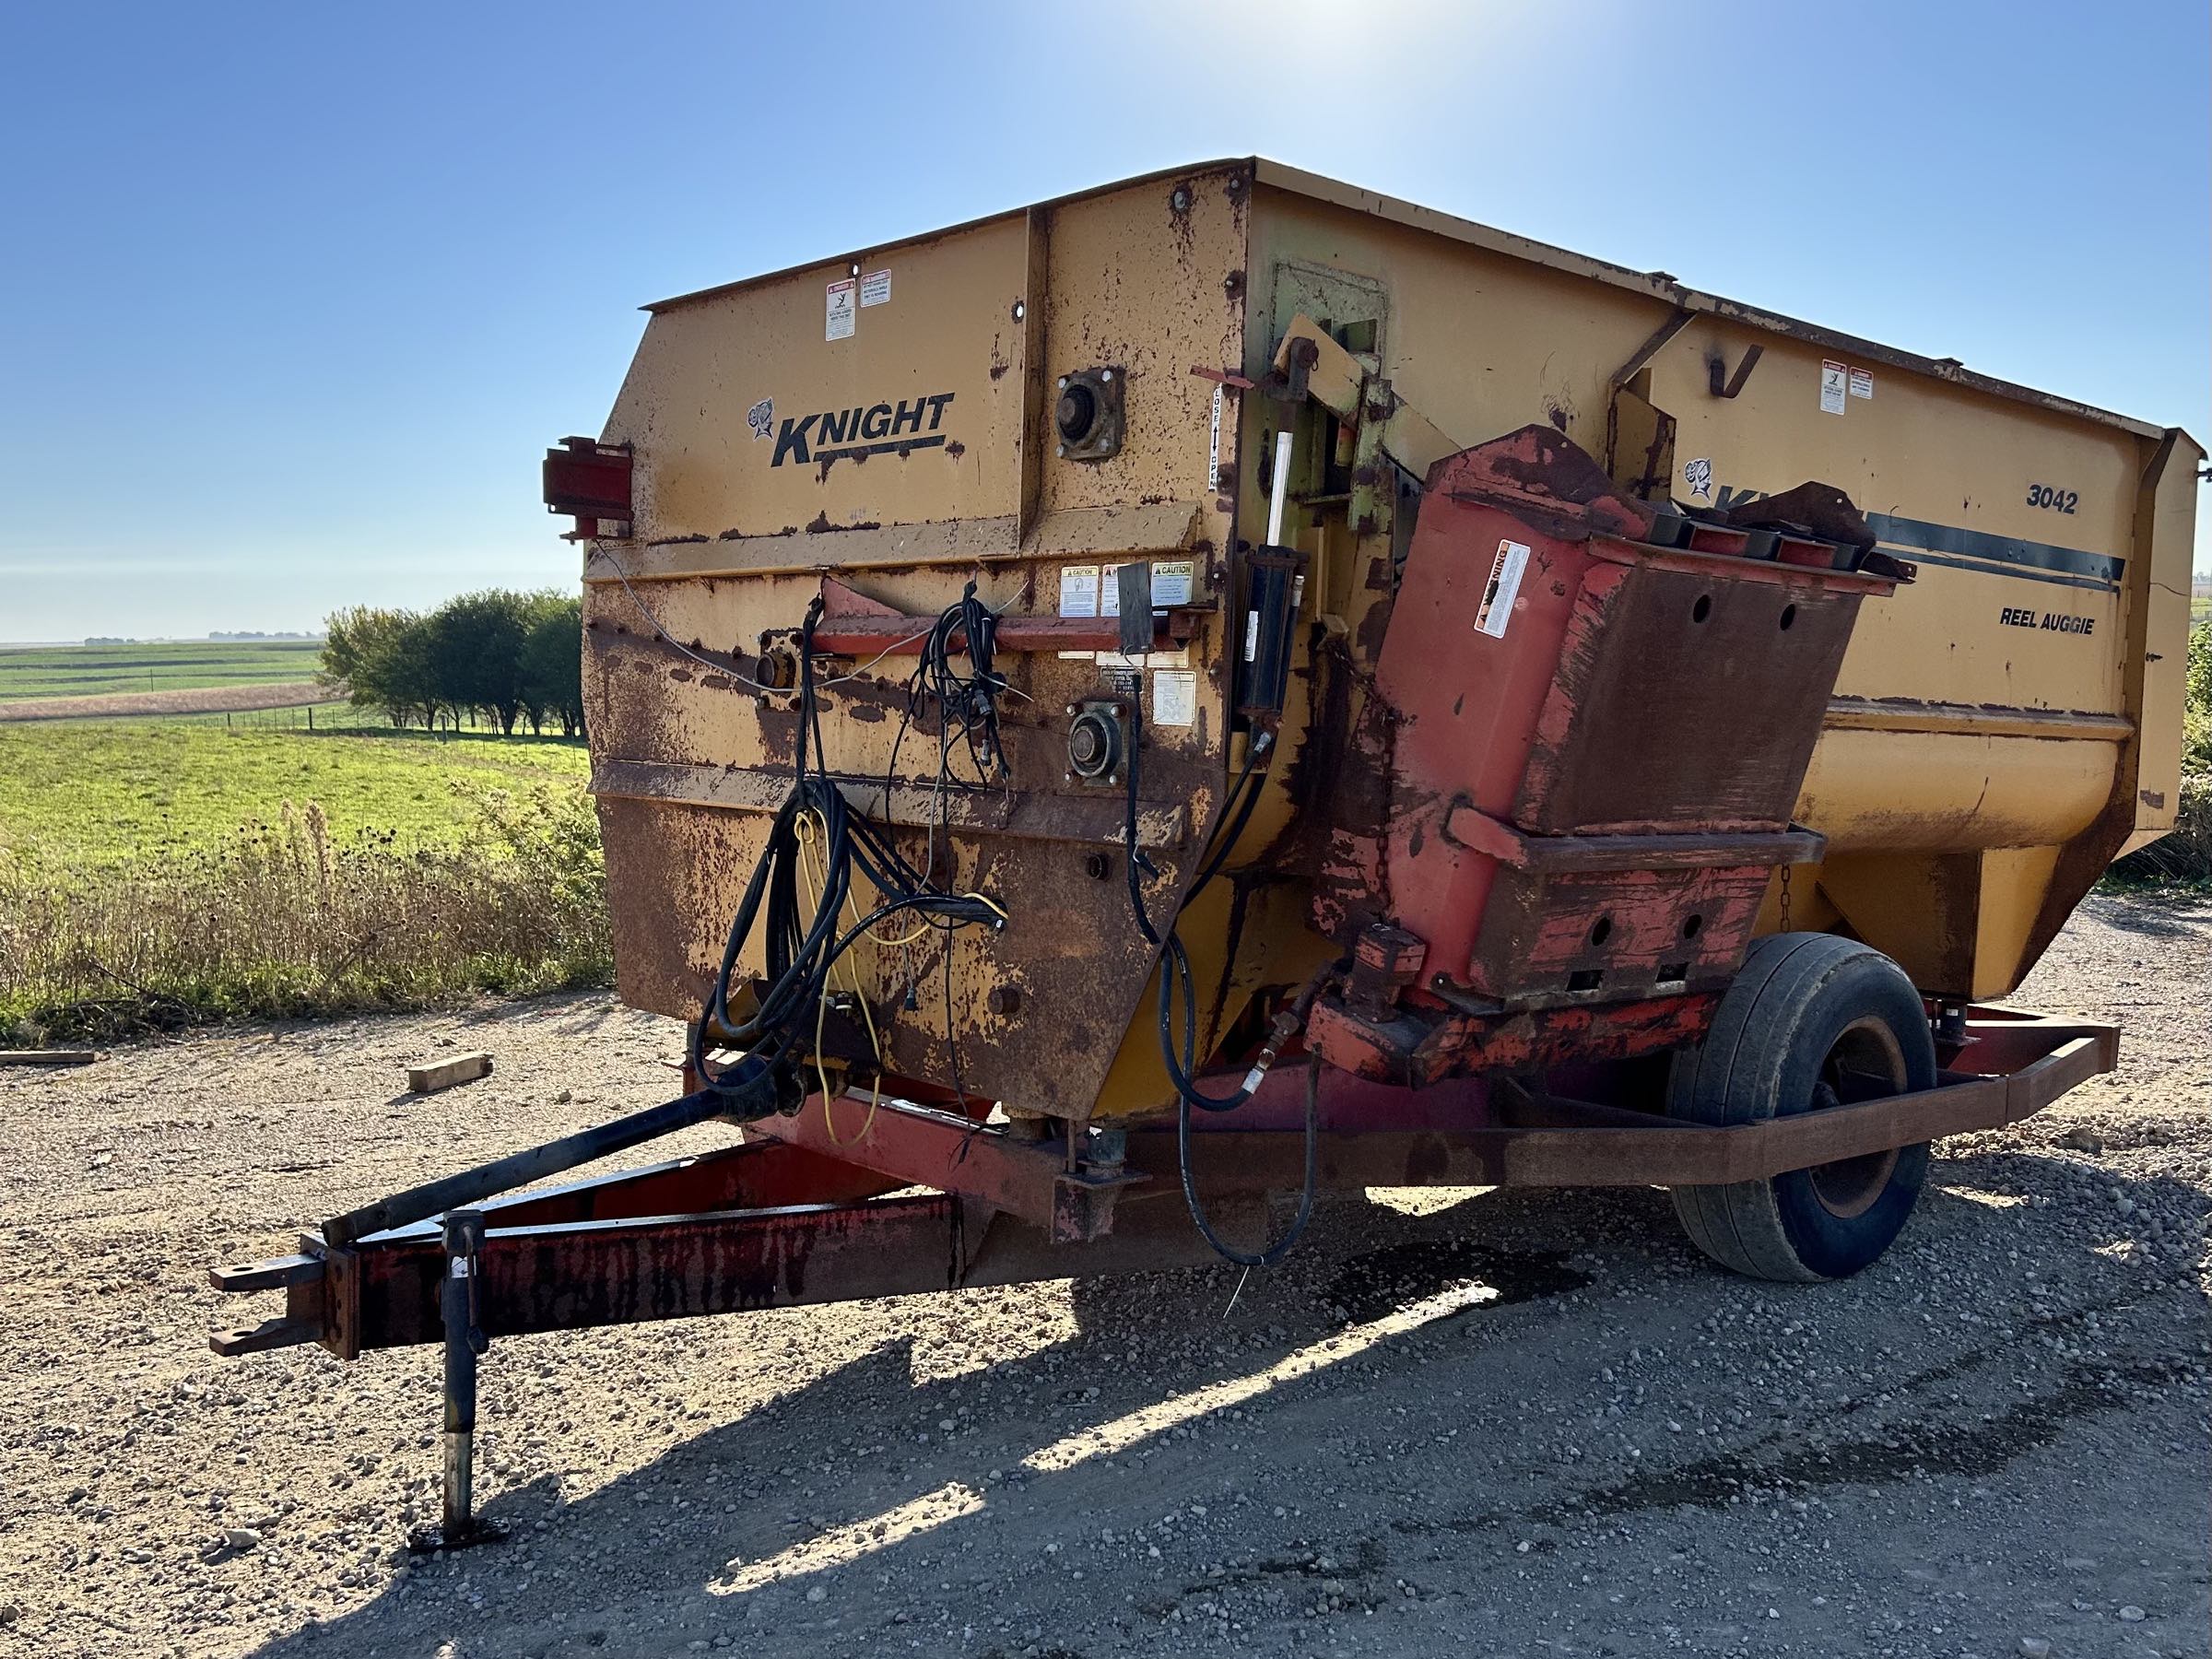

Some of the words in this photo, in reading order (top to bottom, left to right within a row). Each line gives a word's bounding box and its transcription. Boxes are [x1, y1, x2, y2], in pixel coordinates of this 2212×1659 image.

[771, 393, 955, 467] KNIGHT
[2027, 484, 2077, 514] 3042
[1161, 565, 1191, 574] CAUTION
[2000, 607, 2037, 628] REEL
[2040, 613, 2095, 635] AUGGIE
